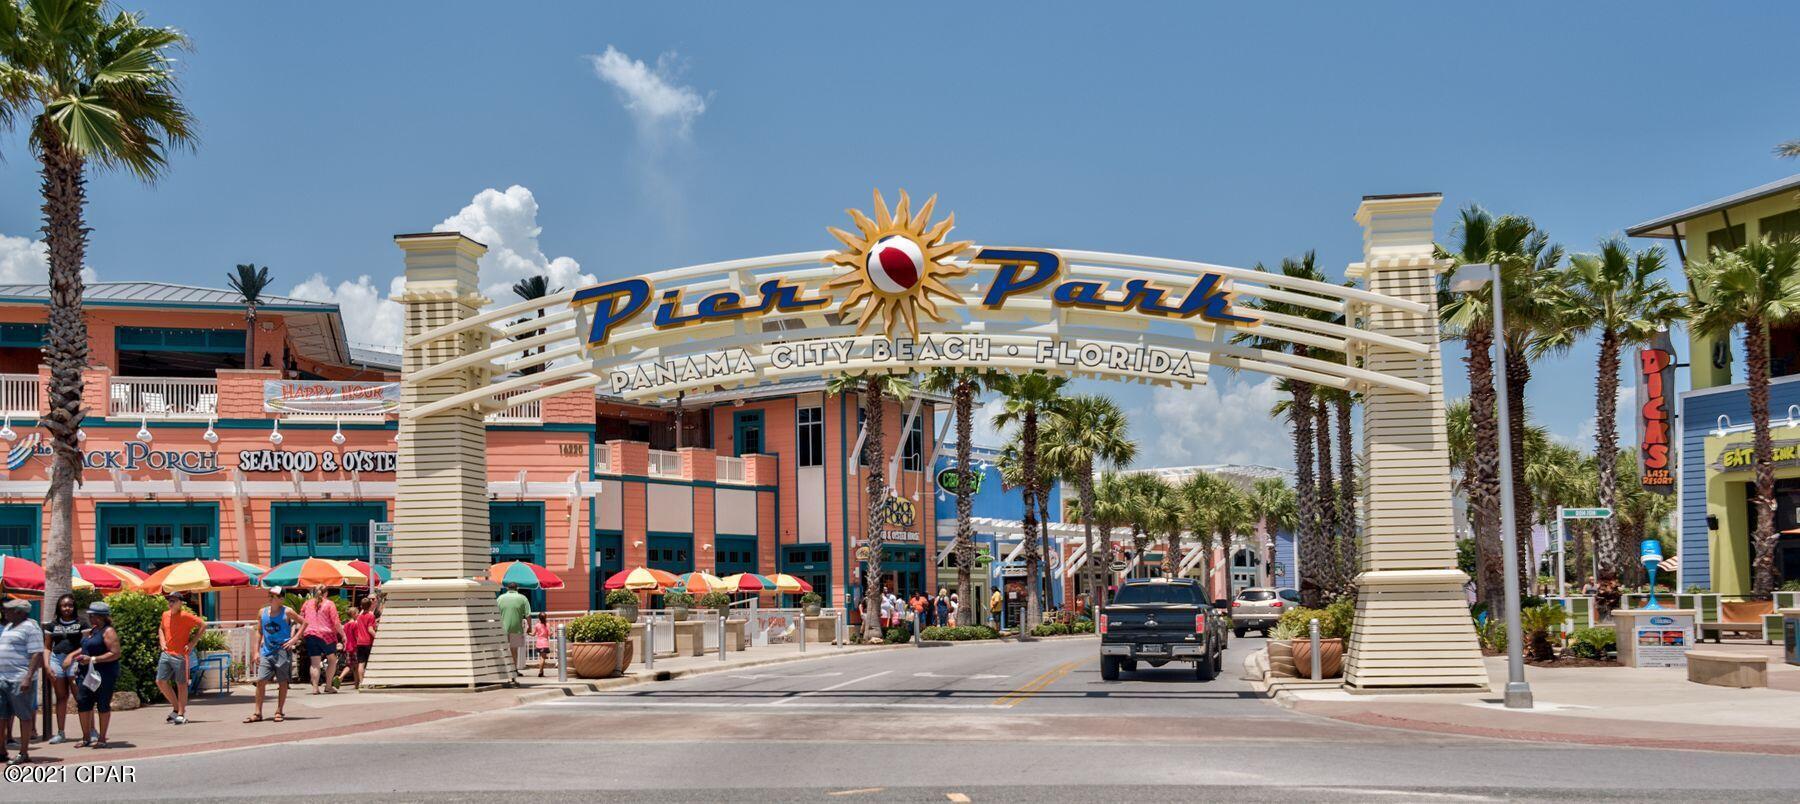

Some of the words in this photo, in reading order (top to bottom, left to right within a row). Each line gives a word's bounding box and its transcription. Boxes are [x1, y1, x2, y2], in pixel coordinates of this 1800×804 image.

[570, 277, 834, 348] Pier
[970, 246, 1264, 328] Park
[610, 348, 756, 394] PANAMA
[770, 339, 855, 370] CITY
[871, 335, 991, 362] BEACH
[1035, 340, 1195, 379] FLORIDA
[281, 383, 336, 400] HAPPY
[341, 384, 384, 400] HOUR
[32, 441, 53, 456] the
[238, 450, 317, 472] SEAFOOD
[322, 451, 339, 472] &
[1642, 476, 1674, 485] RESORT
[1646, 470, 1669, 478] LAST
